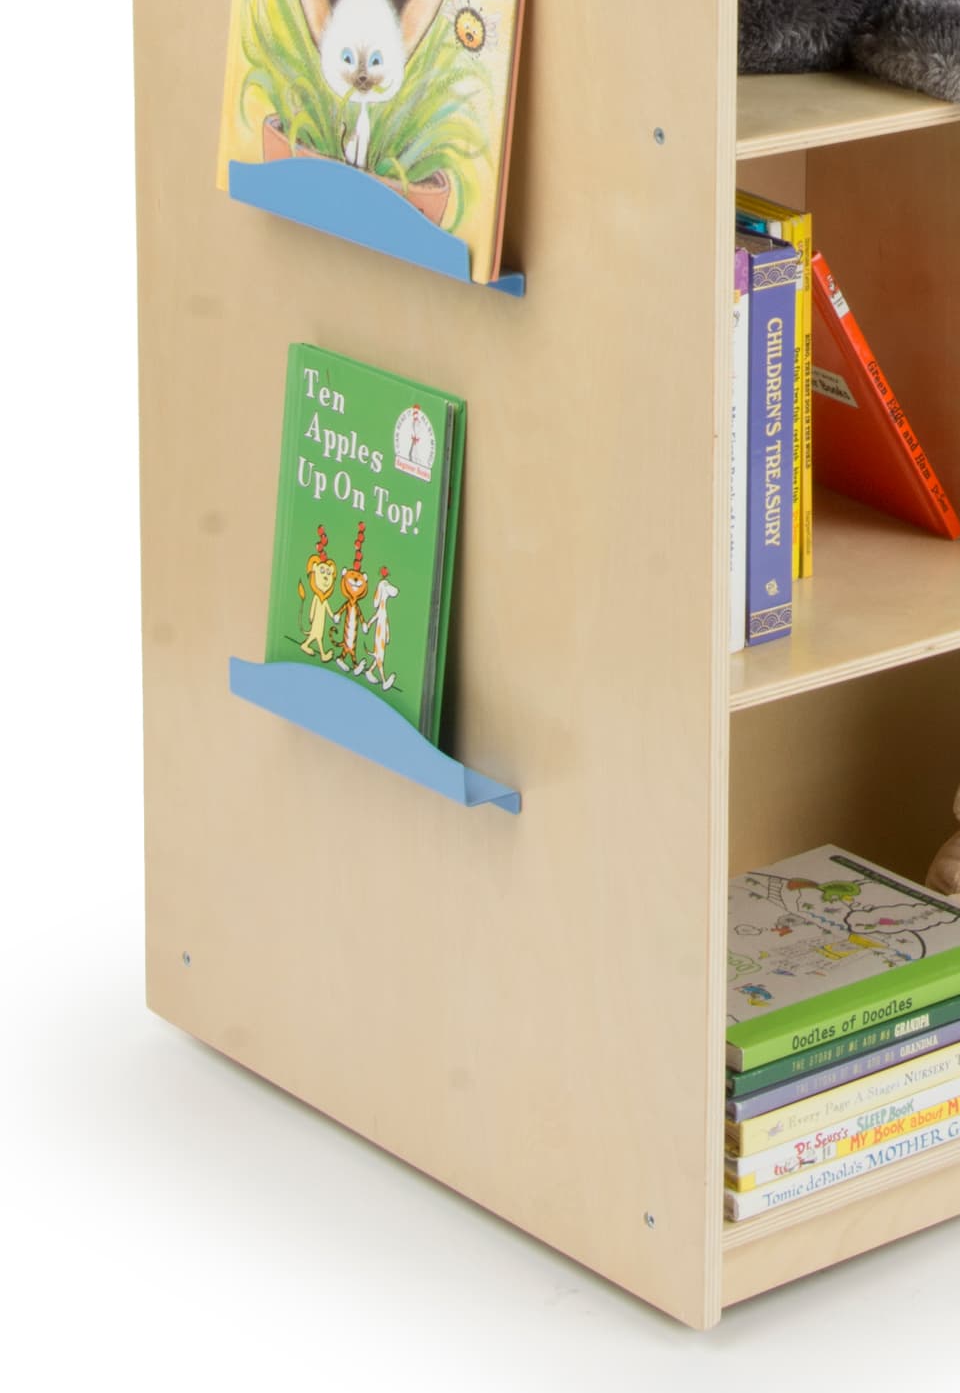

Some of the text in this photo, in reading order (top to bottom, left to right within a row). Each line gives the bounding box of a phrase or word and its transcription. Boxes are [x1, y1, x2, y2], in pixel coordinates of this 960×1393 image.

[303, 367, 346, 416] Ten
[304, 411, 384, 475] Apples
[764, 316, 784, 548] CHILDREN'S TREASURY
[867, 361, 888, 395] Green
[903, 430, 918, 452] and
[914, 455, 931, 481] Ham
[297, 456, 423, 536] Up On Top!
[792, 997, 913, 1050] Oodles of Doodles
[894, 1013, 931, 1037] GRANDPA
[900, 1034, 939, 1057] GRANDMA
[904, 1061, 952, 1086] NURSERY
[793, 1140, 812, 1157] Dr.
[814, 1127, 849, 1148] Seuss's
[856, 1107, 889, 1131] SLEEP
[850, 1132, 869, 1152] MY
[910, 1107, 945, 1129] about
[762, 1183, 805, 1208] Tomie
[805, 1160, 864, 1192] dePaola's
[867, 1129, 945, 1169] MOTHER
